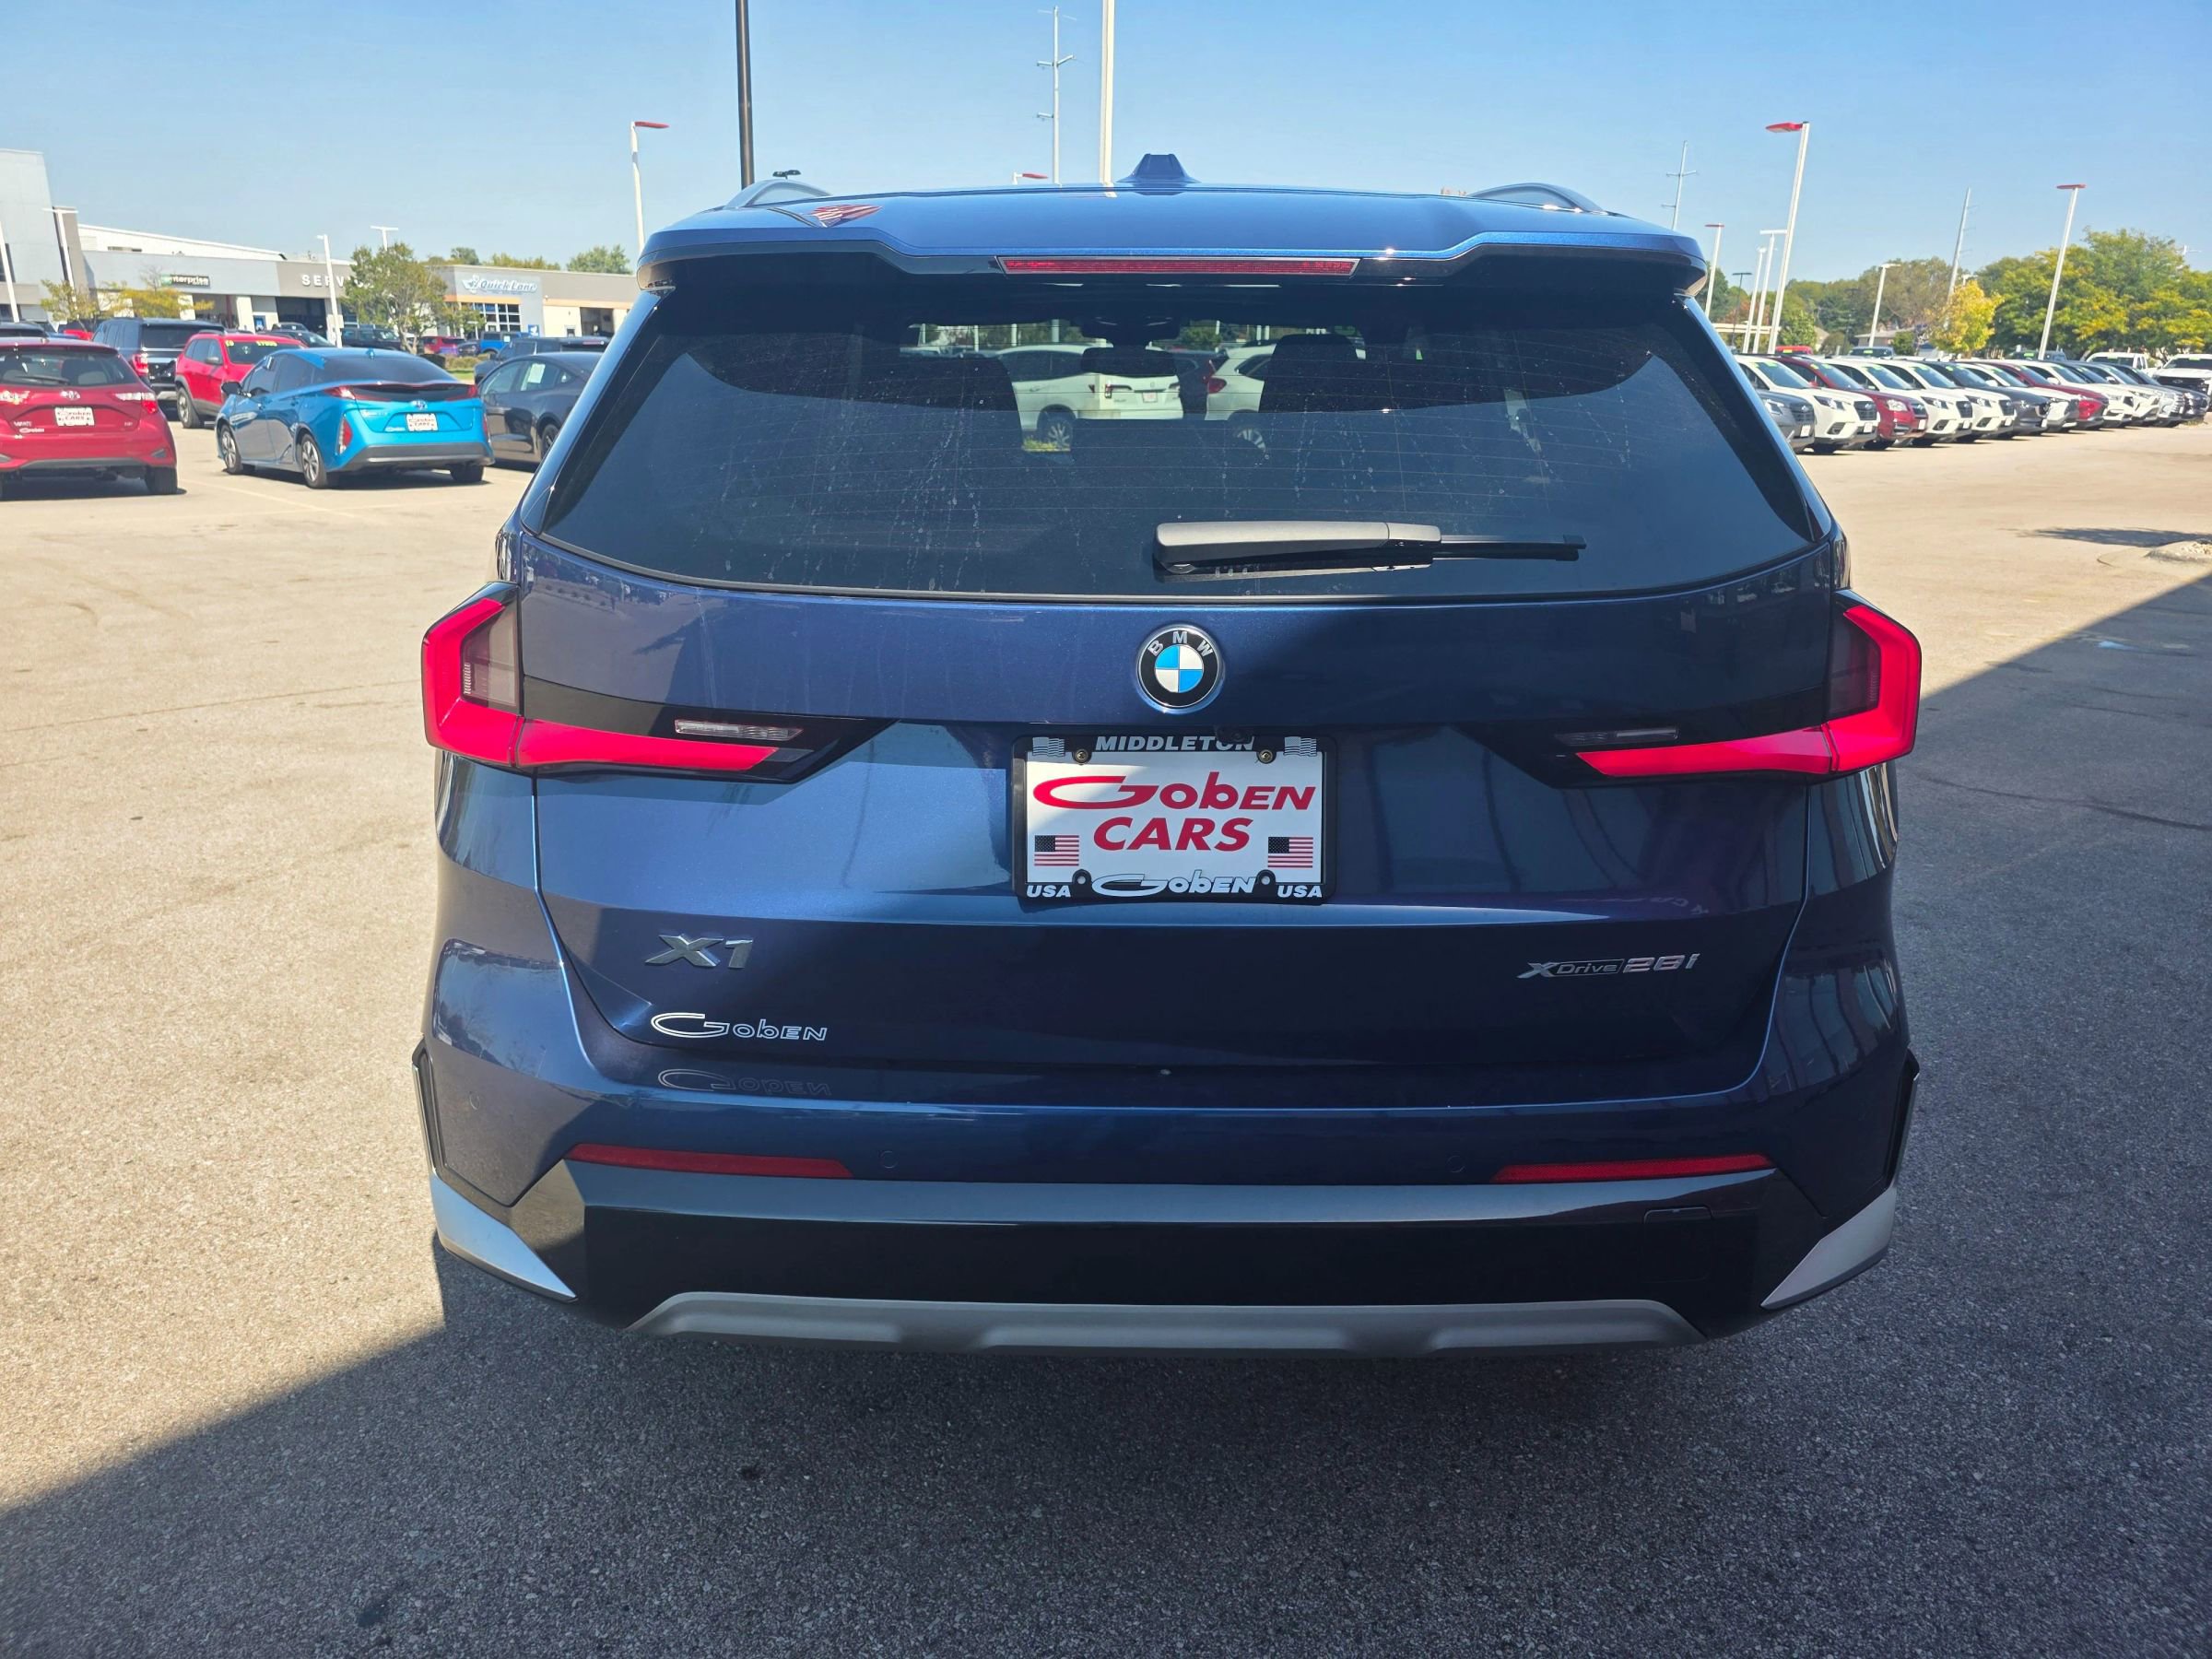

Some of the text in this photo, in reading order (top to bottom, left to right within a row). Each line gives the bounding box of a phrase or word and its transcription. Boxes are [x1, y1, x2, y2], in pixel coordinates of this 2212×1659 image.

[1147, 630, 1213, 657] BMW
[1093, 817, 1253, 852] CARS
[1027, 885, 1071, 898] USA
[1277, 885, 1323, 899] USA
[645, 935, 753, 968] X1
